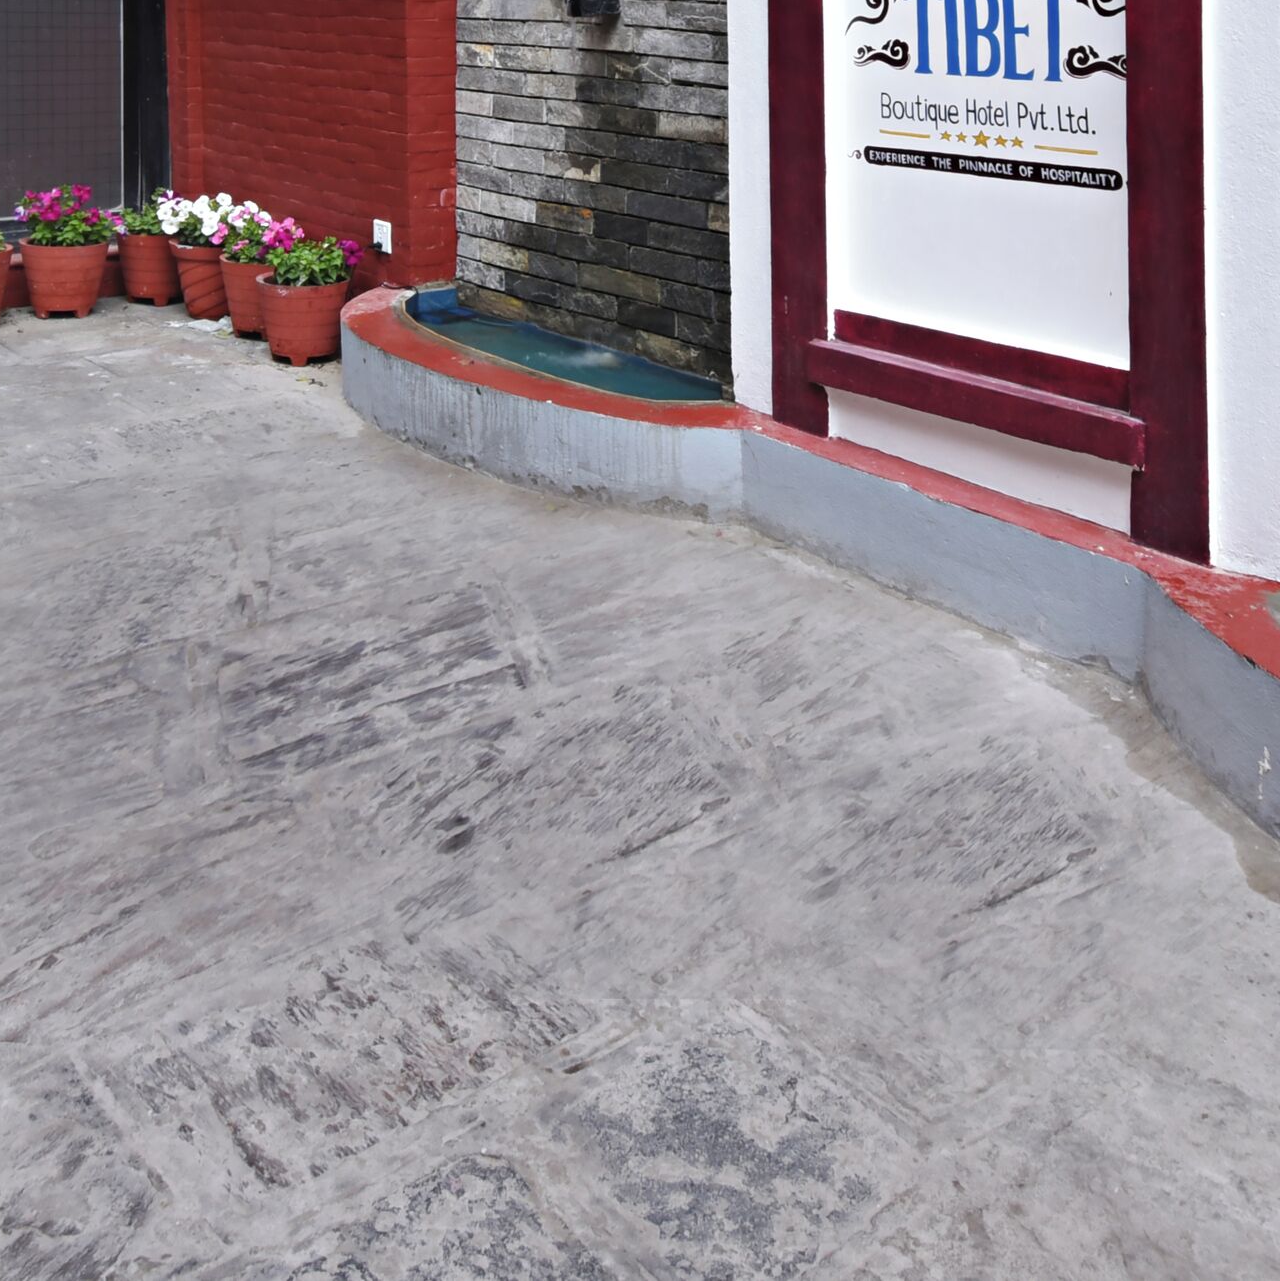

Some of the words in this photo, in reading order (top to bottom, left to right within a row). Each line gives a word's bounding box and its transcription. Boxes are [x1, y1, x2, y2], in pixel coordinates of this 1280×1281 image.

[880, 92, 959, 130] Boutique
[966, 98, 1009, 128] Hotel
[869, 150, 926, 167] EXPERIENCE
[931, 157, 952, 170] THE
[958, 158, 1013, 176] PINNACLE
[1019, 165, 1034, 178] OF
[1041, 167, 1117, 188] HOSPITALITY
